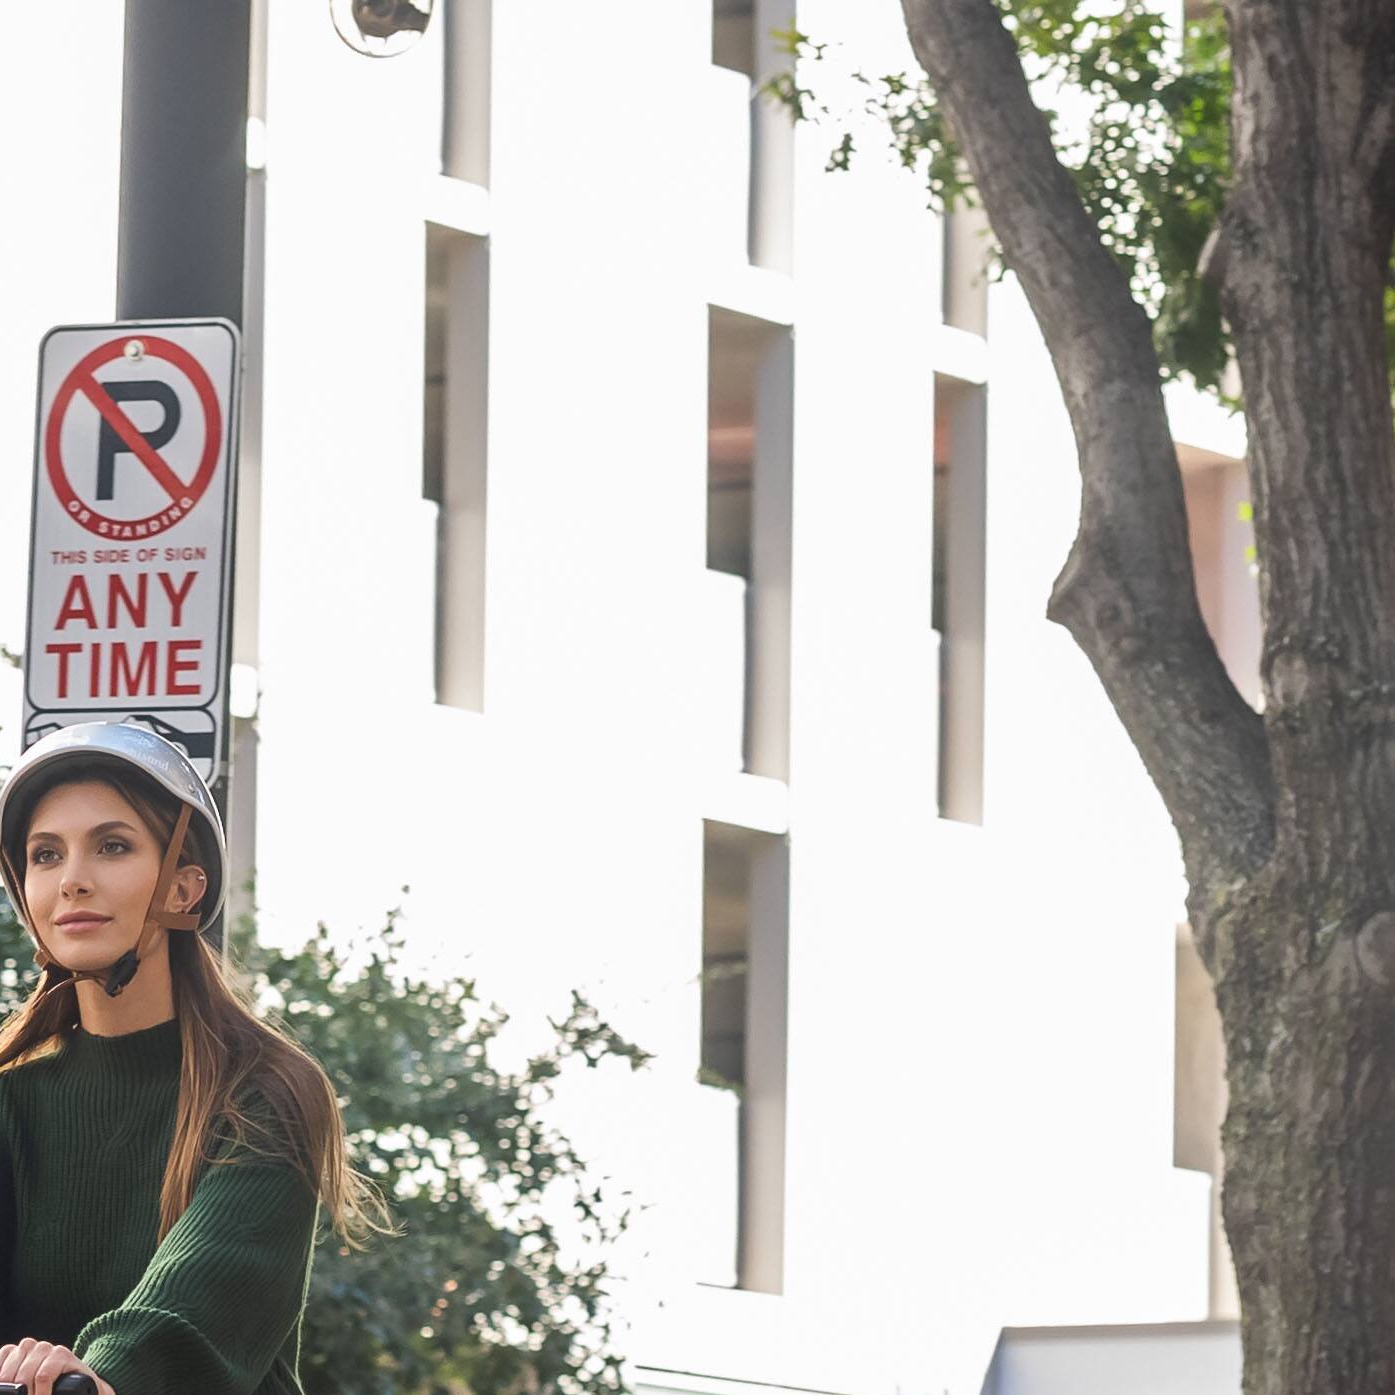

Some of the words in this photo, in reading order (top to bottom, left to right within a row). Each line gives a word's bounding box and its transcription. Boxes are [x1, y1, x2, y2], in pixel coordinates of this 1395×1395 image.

[68, 500, 91, 523] OR
[98, 497, 193, 537] STANDING
[51, 551, 87, 565] THIS
[93, 550, 129, 564] SIDE
[136, 548, 159, 562] OF
[165, 547, 207, 561] SIGN
[54, 571, 198, 630] ANY
[45, 640, 202, 698] TIME
